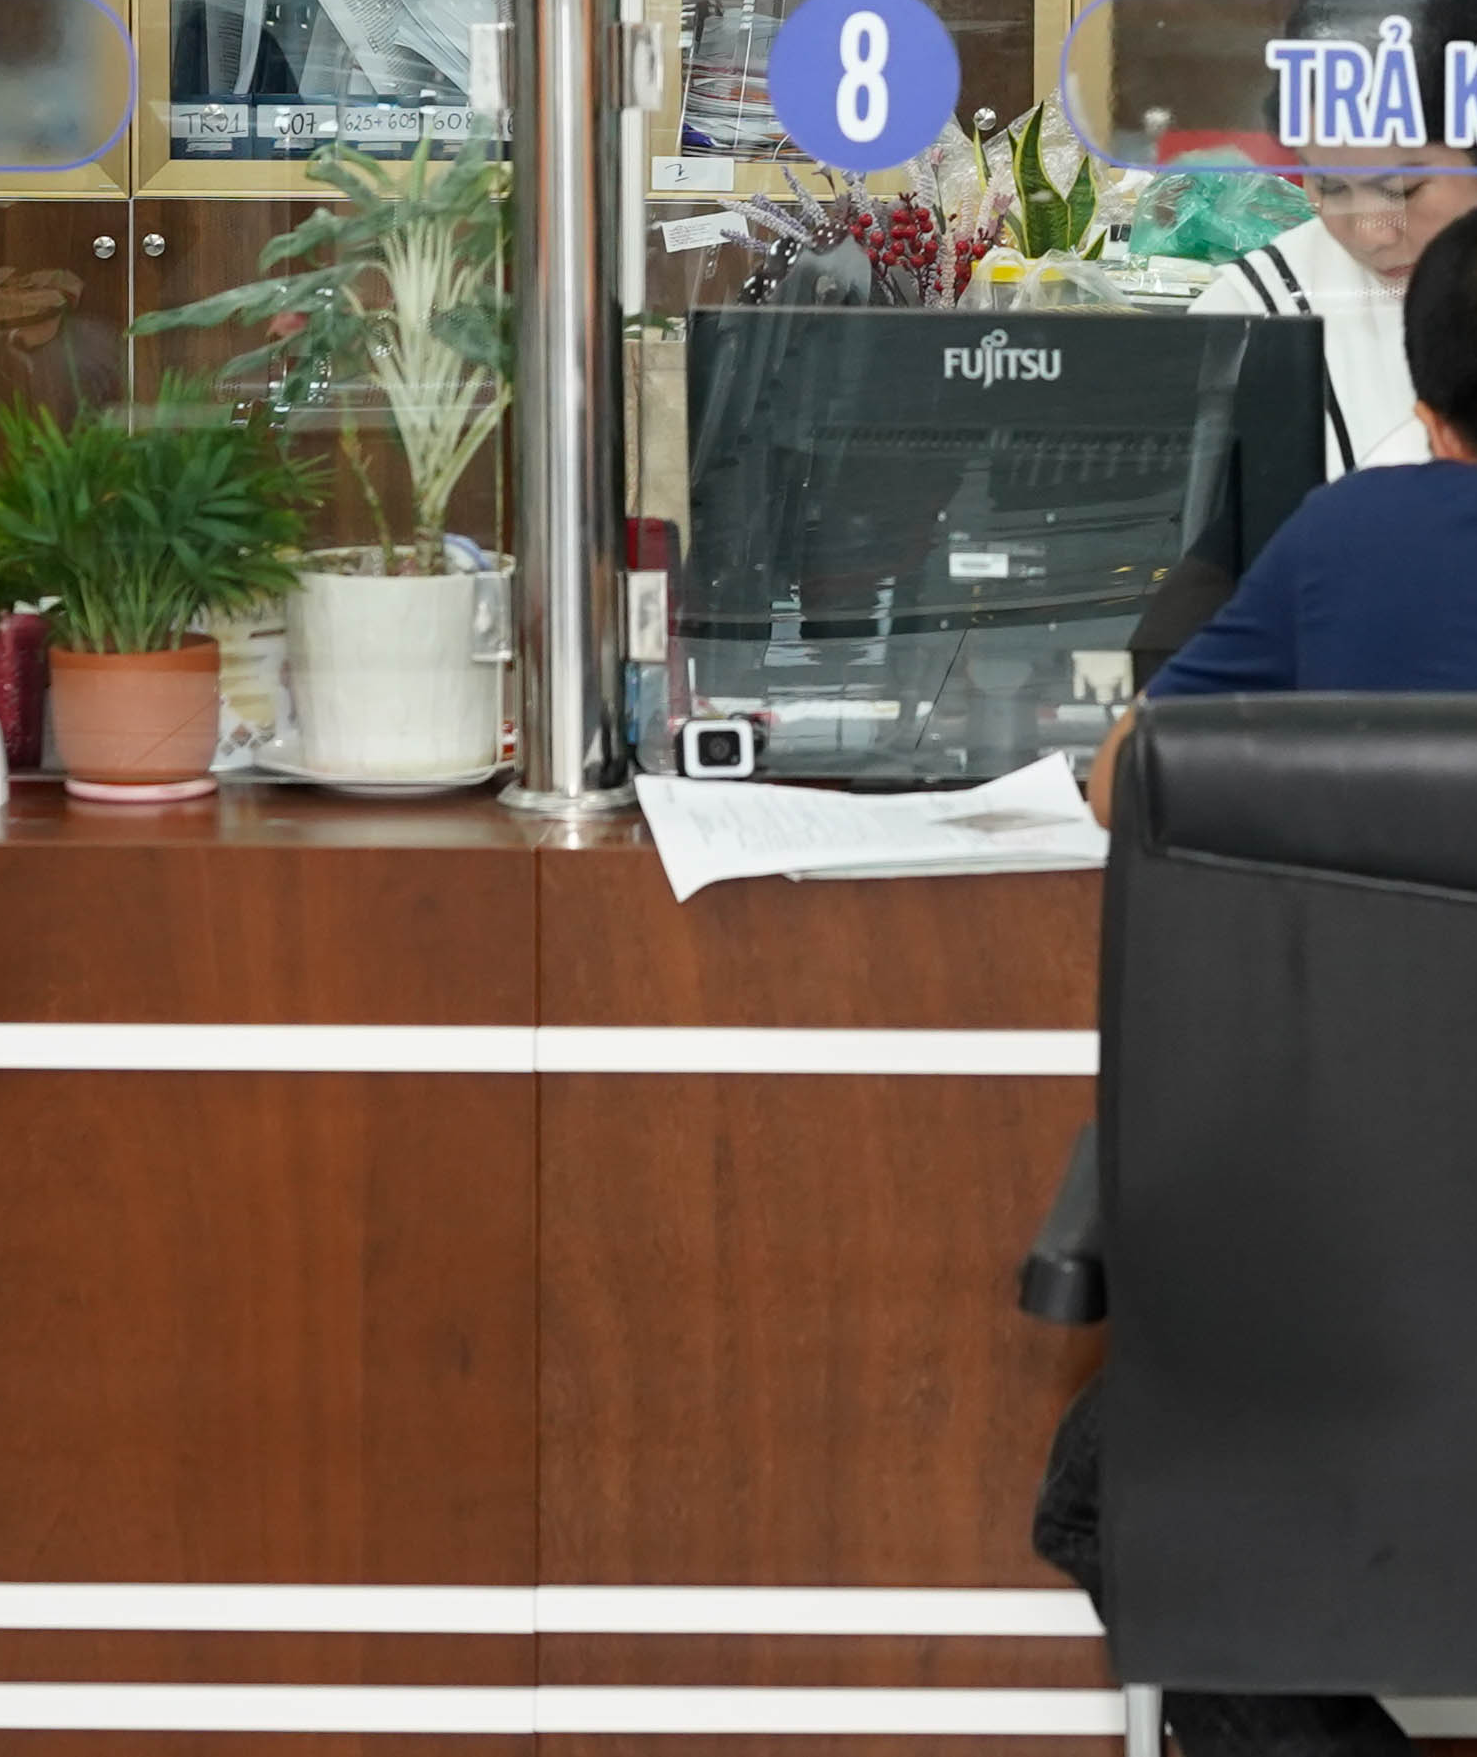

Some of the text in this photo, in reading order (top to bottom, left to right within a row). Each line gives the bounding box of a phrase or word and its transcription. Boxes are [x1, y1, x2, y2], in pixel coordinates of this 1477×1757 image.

[835, 9, 891, 144] 8
[1265, 14, 1426, 148] TRẢ
[943, 328, 1062, 390] FUJITSU
